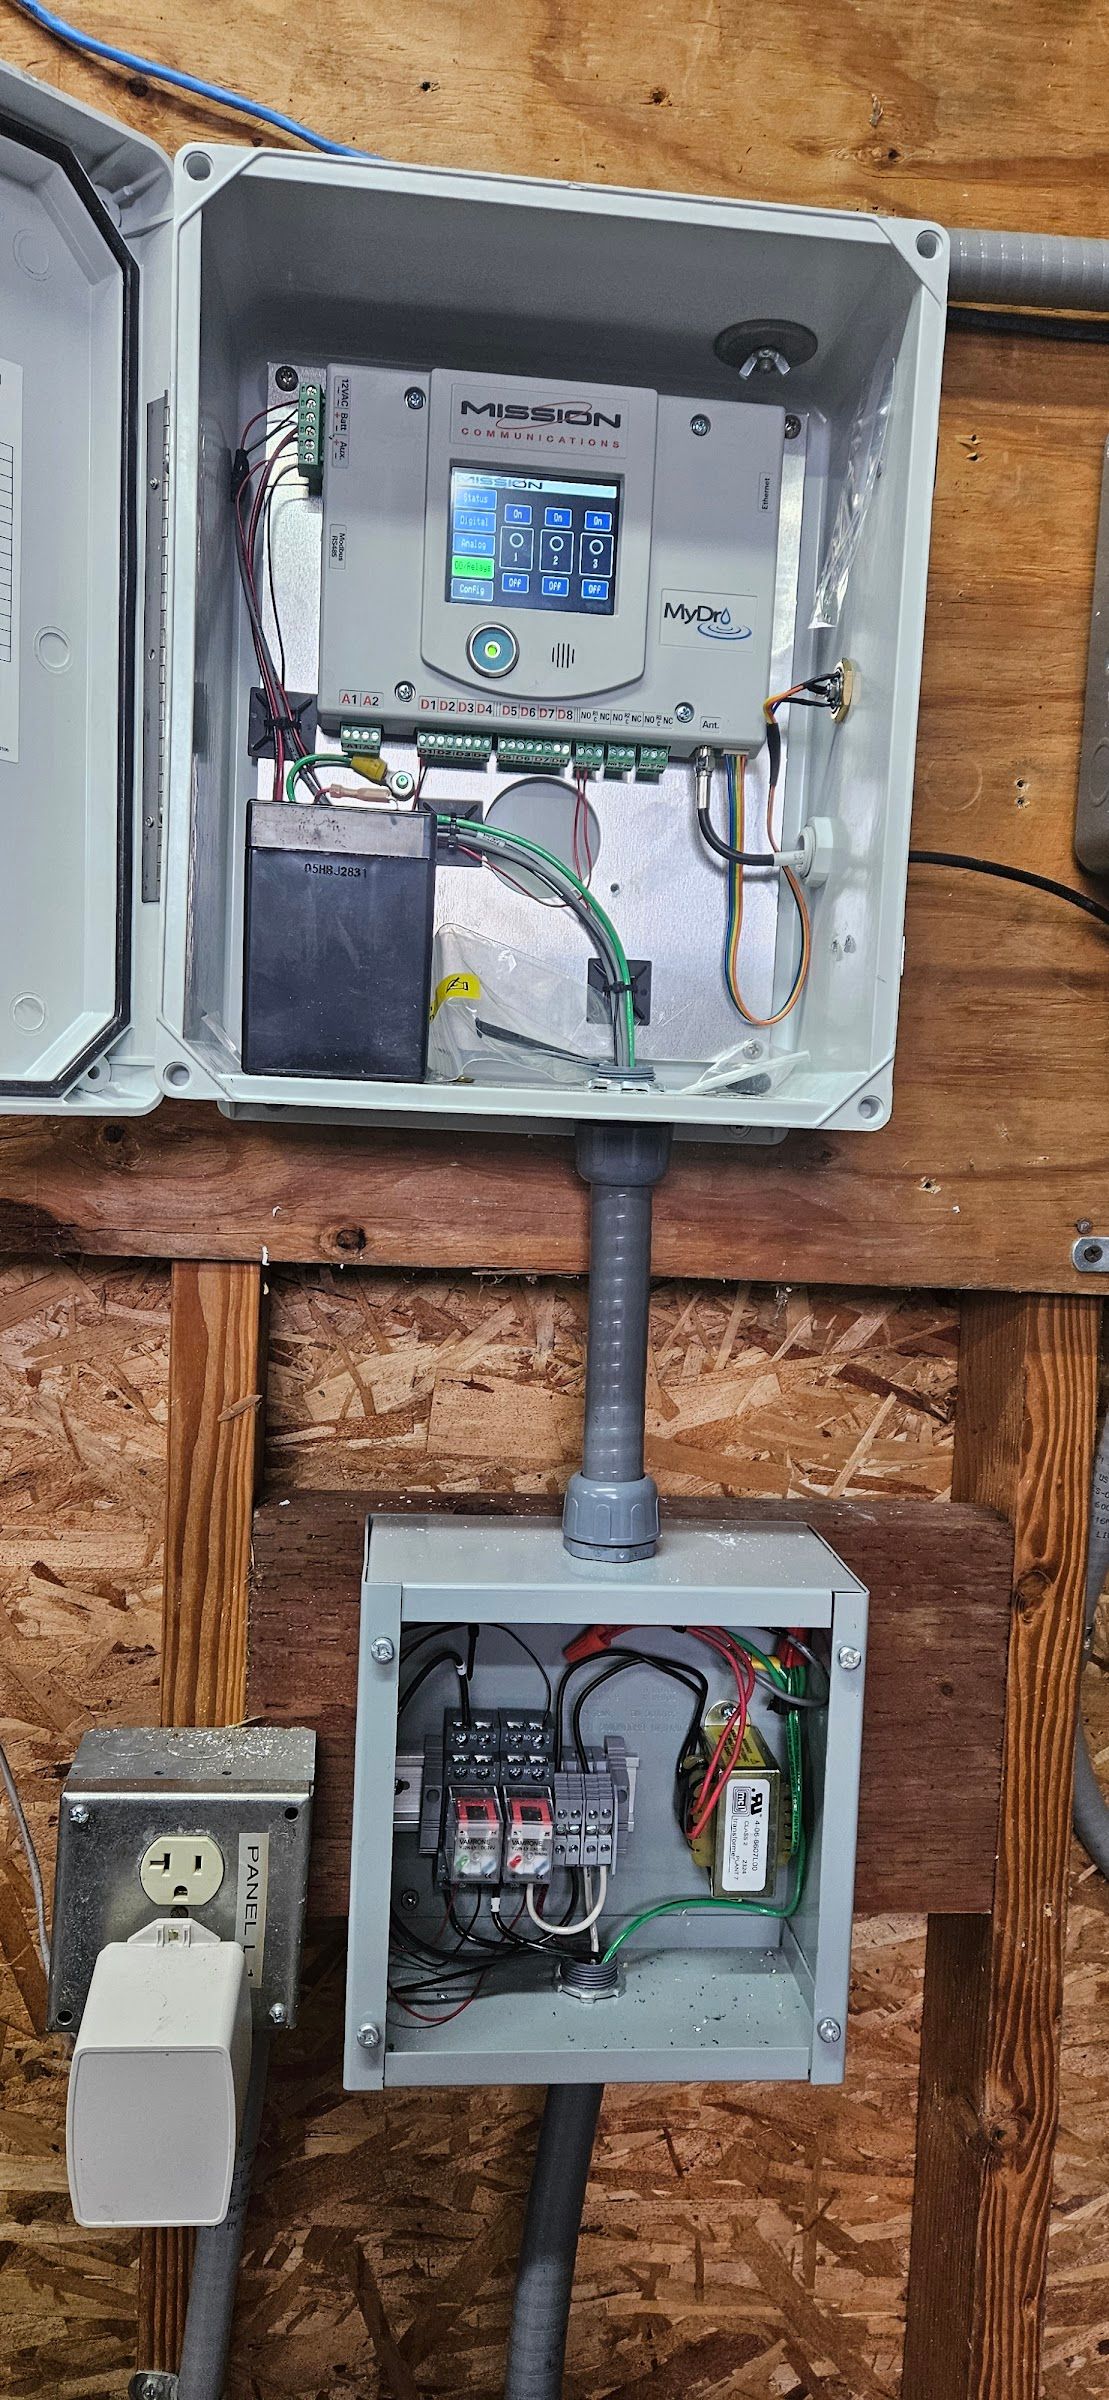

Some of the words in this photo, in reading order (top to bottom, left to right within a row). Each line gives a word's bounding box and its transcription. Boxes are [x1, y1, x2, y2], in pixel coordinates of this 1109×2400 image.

[341, 379, 349, 407] 12VAC
[461, 400, 622, 429] MISSION
[340, 412, 348, 431] Batt
[461, 427, 620, 449] COMMUNICATIONS
[339, 440, 347, 460] Aux.
[457, 475, 543, 490] MISSION
[463, 491, 489, 503] Status
[762, 478, 770, 510] Ethernet
[513, 509, 523, 519] On
[553, 512, 563, 523] On
[460, 515, 489, 528] Digital
[593, 516, 603, 526] On
[338, 533, 346, 561] Modbus
[461, 538, 487, 551] Analog
[553, 555, 559, 566] 2
[592, 558, 598, 569] 3
[508, 578, 522, 588] Off
[548, 581, 562, 591] Off
[459, 584, 485, 596] Config
[588, 584, 602, 595] Off
[341, 693, 357, 705] A1
[362, 695, 379, 707] A2
[420, 699, 436, 710] D1
[439, 700, 455, 712] D2
[458, 701, 474, 713] D3
[477, 703, 493, 714] D4
[502, 705, 517, 716] D5
[520, 706, 536, 718] D6
[540, 708, 555, 719] D7
[558, 709, 573, 720] D8
[580, 711, 592, 720] NO
[600, 712, 610, 721] NC
[612, 713, 623, 721] NO
[631, 715, 642, 723] NC
[644, 715, 655, 724] NO
[663, 717, 674, 725] NC
[702, 720, 720, 729] Ant.
[244, 1846, 259, 1936] PANEL
